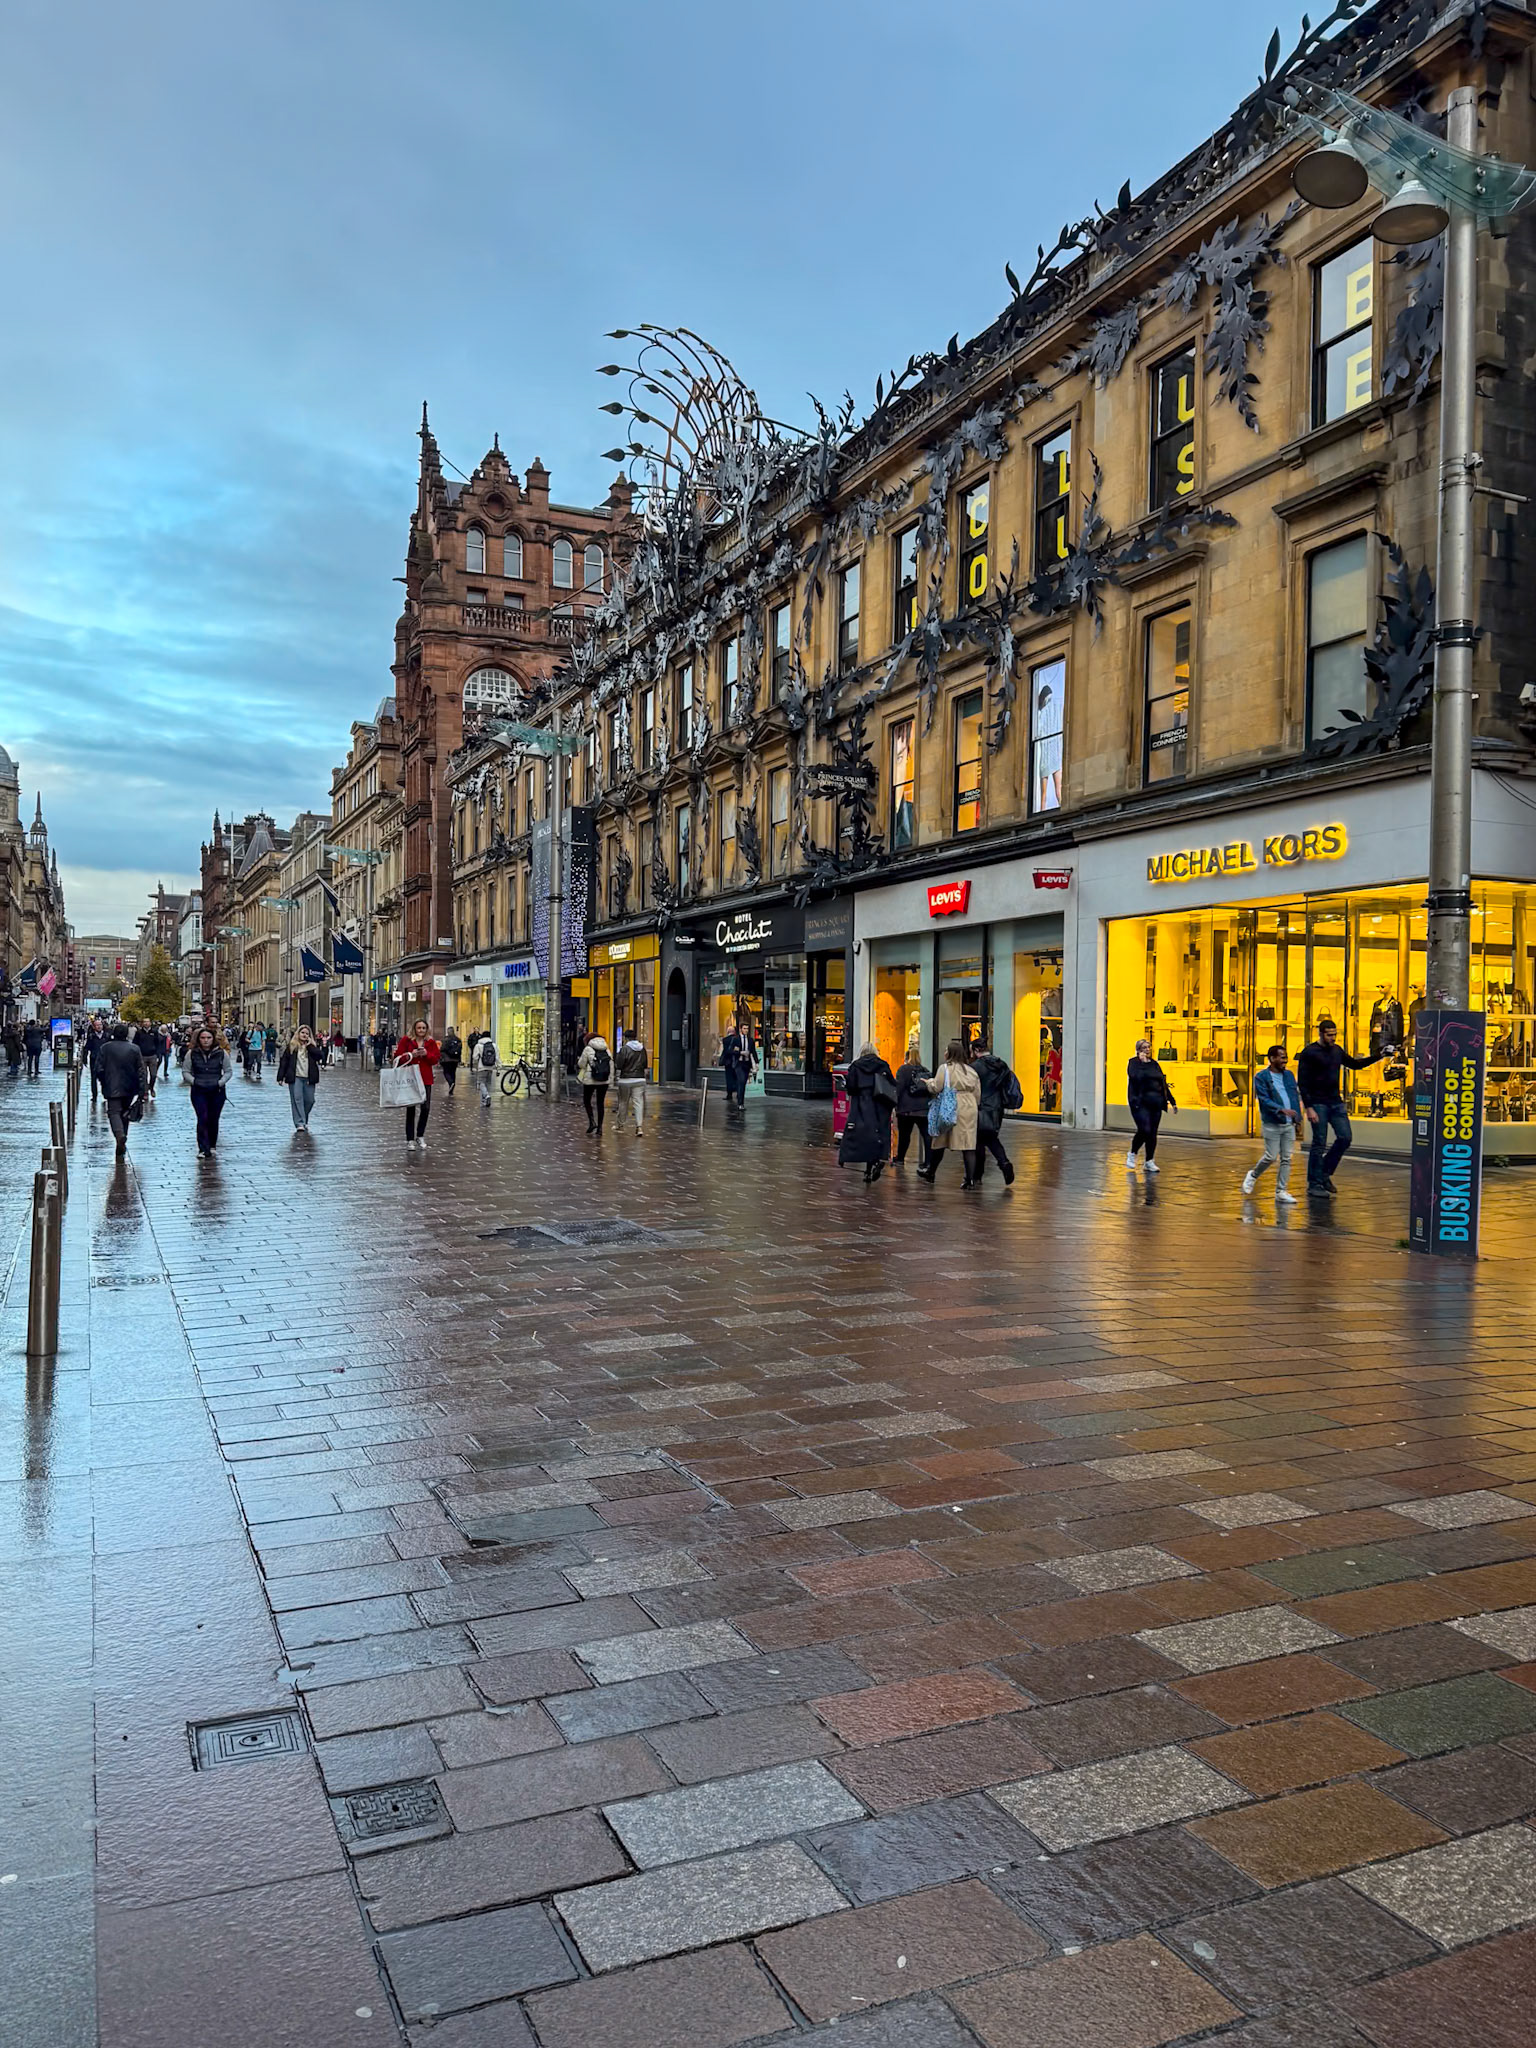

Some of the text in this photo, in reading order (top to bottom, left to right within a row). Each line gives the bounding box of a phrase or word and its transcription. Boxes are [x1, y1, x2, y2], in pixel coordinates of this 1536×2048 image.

[817, 772, 867, 784] PRINCES SQUARE
[1147, 825, 1344, 881] MICHAEL KORS
[735, 913, 752, 924] HOTEL
[505, 961, 531, 978] OFFICE
[1443, 1068, 1459, 1139] CODE OF
[1460, 1056, 1476, 1140] CONDUCT
[1440, 1143, 1472, 1241] BUSKING
